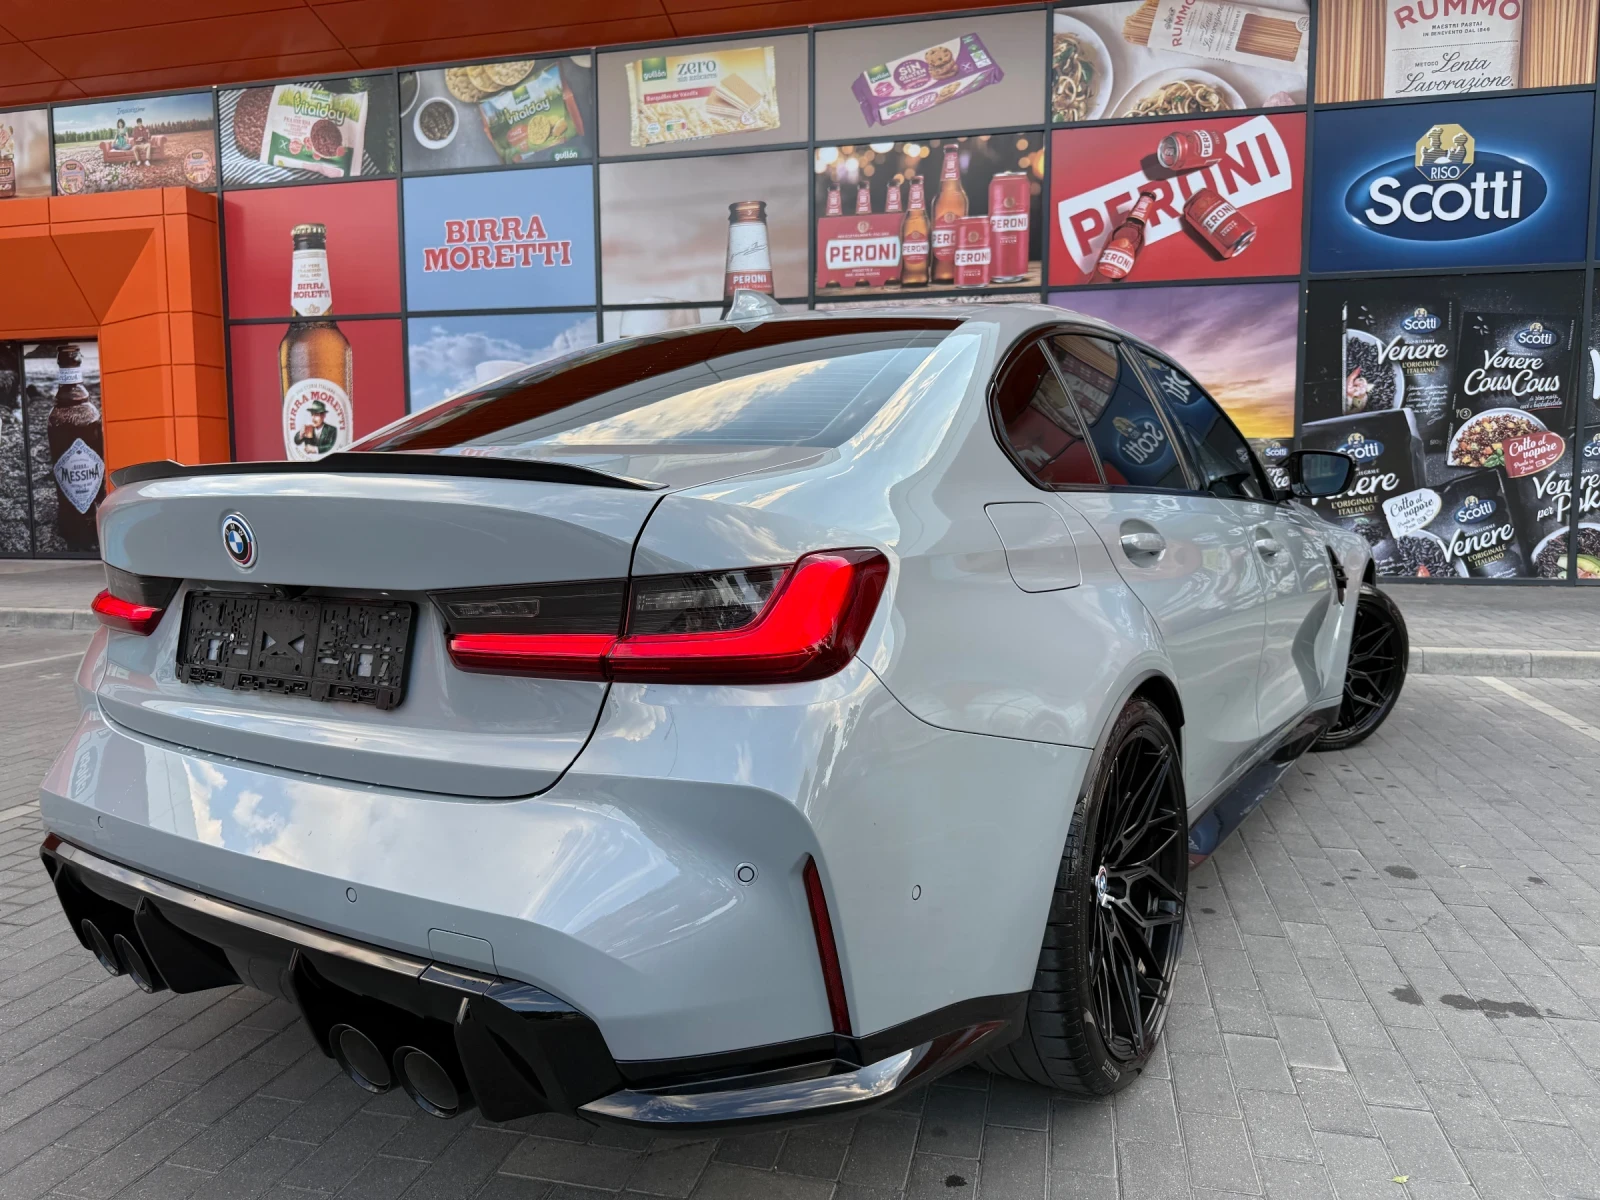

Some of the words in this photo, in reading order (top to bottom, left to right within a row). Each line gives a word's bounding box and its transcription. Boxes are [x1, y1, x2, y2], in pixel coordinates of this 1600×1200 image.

[1394, 0, 1521, 30] RUMMO
[1430, 29, 1463, 37] BENEVENTO
[1432, 52, 1492, 74] Lenta
[293, 91, 345, 126] Vitalday
[1430, 165, 1461, 180] RISO
[1364, 170, 1522, 225] Scotti
[445, 214, 547, 244] BIRRA
[991, 217, 1028, 229] PERONI
[423, 240, 572, 272] MORETTI
[829, 243, 897, 263] PERONI
[297, 282, 326, 290] BIRRA
[732, 274, 767, 285] PERONI
[293, 290, 331, 299] MORETTI
[1403, 317, 1437, 330] Scotti
[1517, 333, 1552, 345] Scotti
[1375, 335, 1449, 365] Venere
[1484, 347, 1545, 370] Venere
[1401, 360, 1440, 369] L'ORIGINALE
[1406, 366, 1436, 374] ITALIANO
[289, 394, 309, 431] BIRRA
[310, 391, 346, 431] MORETTI
[1265, 447, 1288, 457] Scotti
[1509, 436, 1537, 457] Cotto
[1537, 434, 1547, 446] al
[1523, 442, 1558, 459] vapore
[60, 463, 100, 484] MESSINA
[1532, 470, 1600, 499] Venre
[1330, 496, 1380, 509] L'ORIGINALE
[1338, 504, 1375, 516] ITALIANO
[1390, 496, 1415, 518] Cotto
[1415, 492, 1423, 503] al
[1403, 498, 1434, 518] vapore
[1457, 501, 1493, 523] Scotti
[1536, 506, 1554, 522] per
[1436, 523, 1514, 562] Venere
[1467, 543, 1507, 563] L'ORIGINALE
[1474, 552, 1505, 567] ITALIANO
